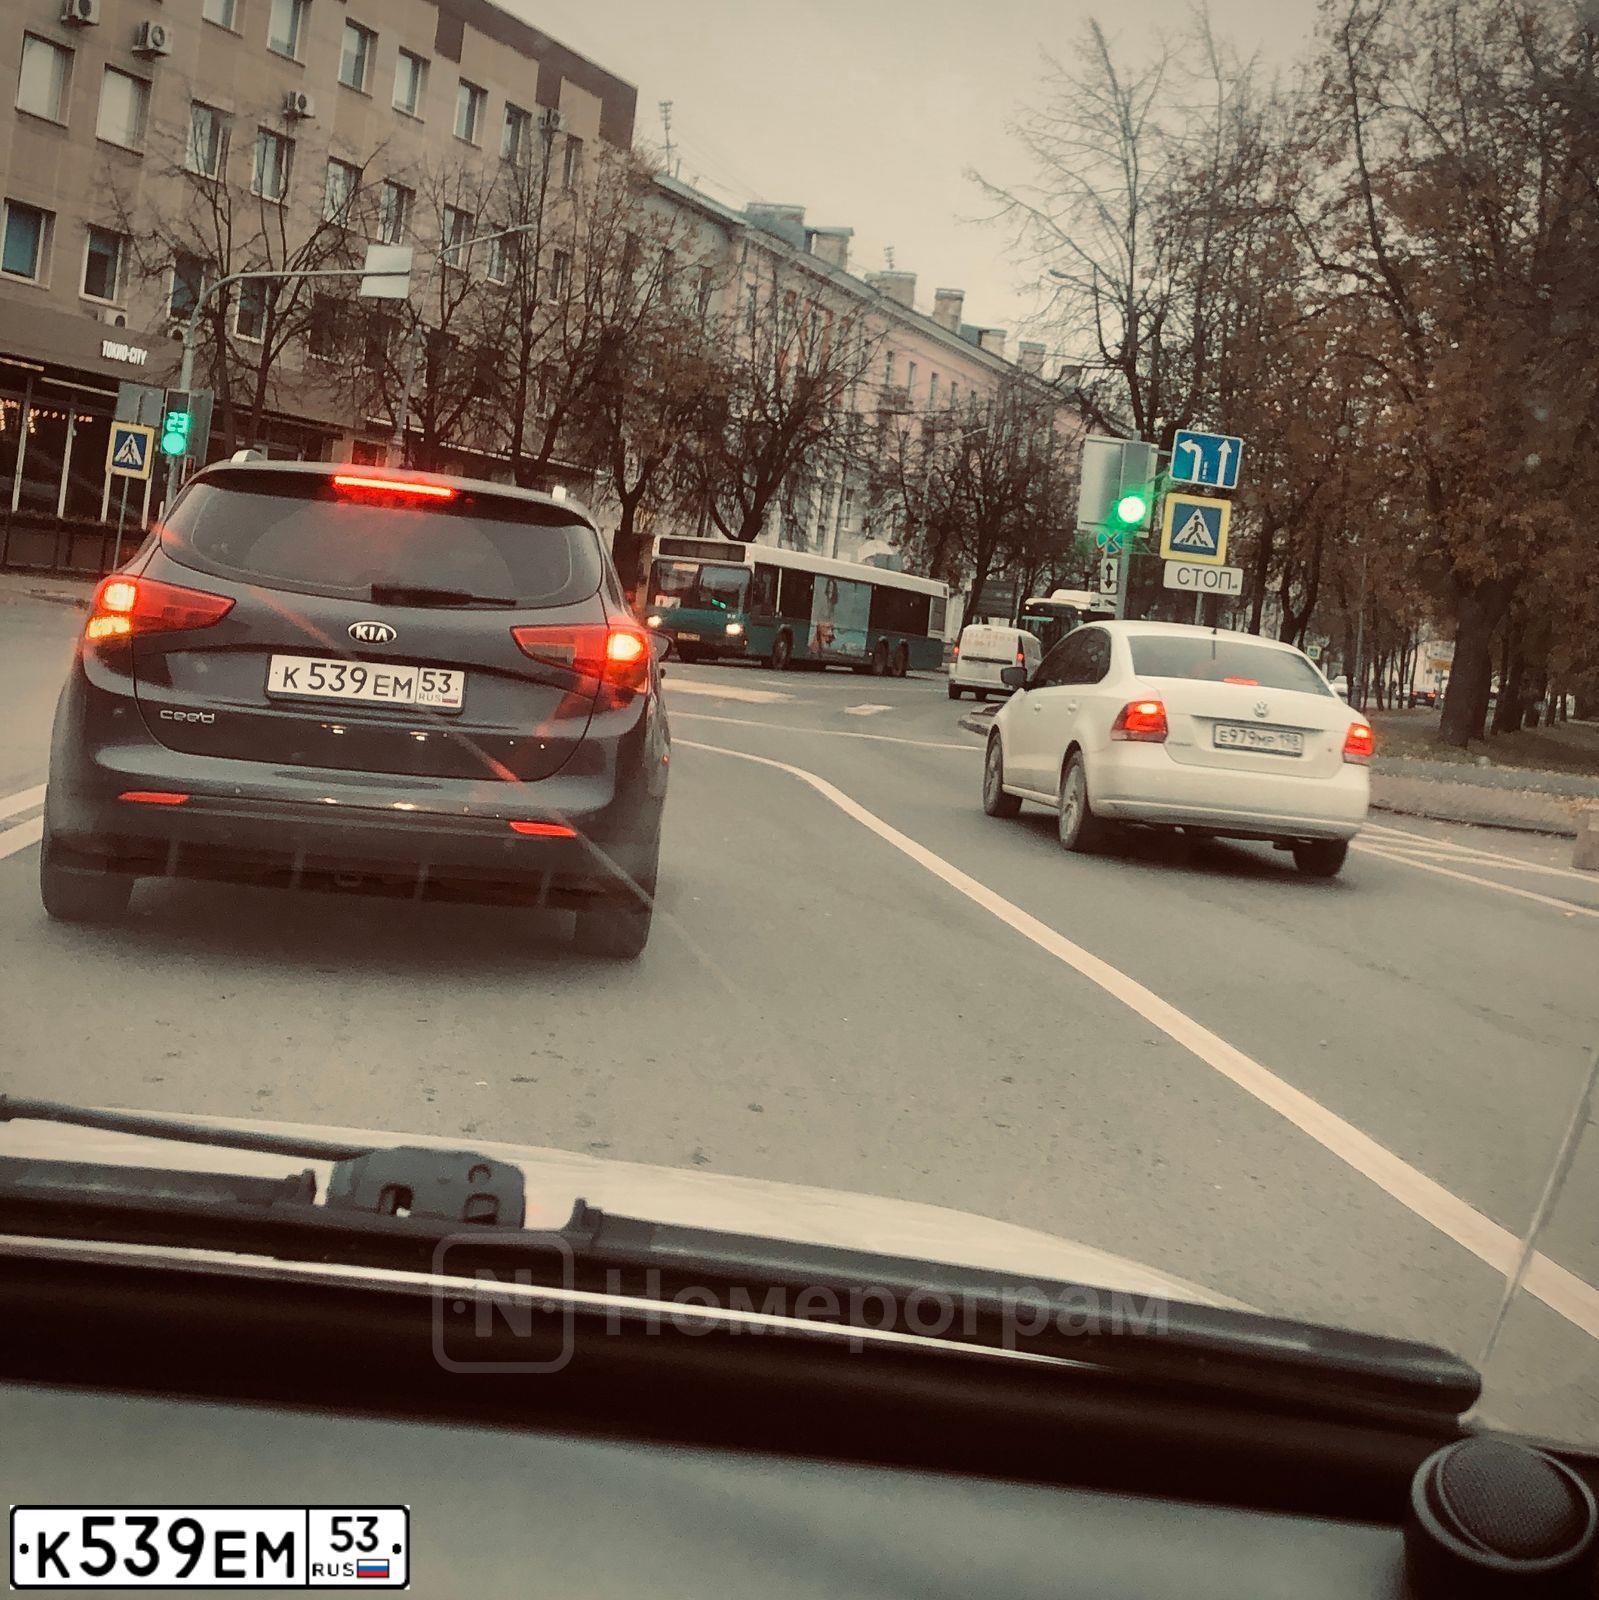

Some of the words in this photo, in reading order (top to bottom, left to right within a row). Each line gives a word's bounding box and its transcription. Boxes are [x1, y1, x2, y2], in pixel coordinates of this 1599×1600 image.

[167, 411, 189, 434] 23
[1177, 566, 1233, 590] СТОП
[355, 624, 390, 642] KIA
[421, 671, 452, 694] 53
[418, 692, 441, 702] RUS
[160, 710, 215, 724] cee'd
